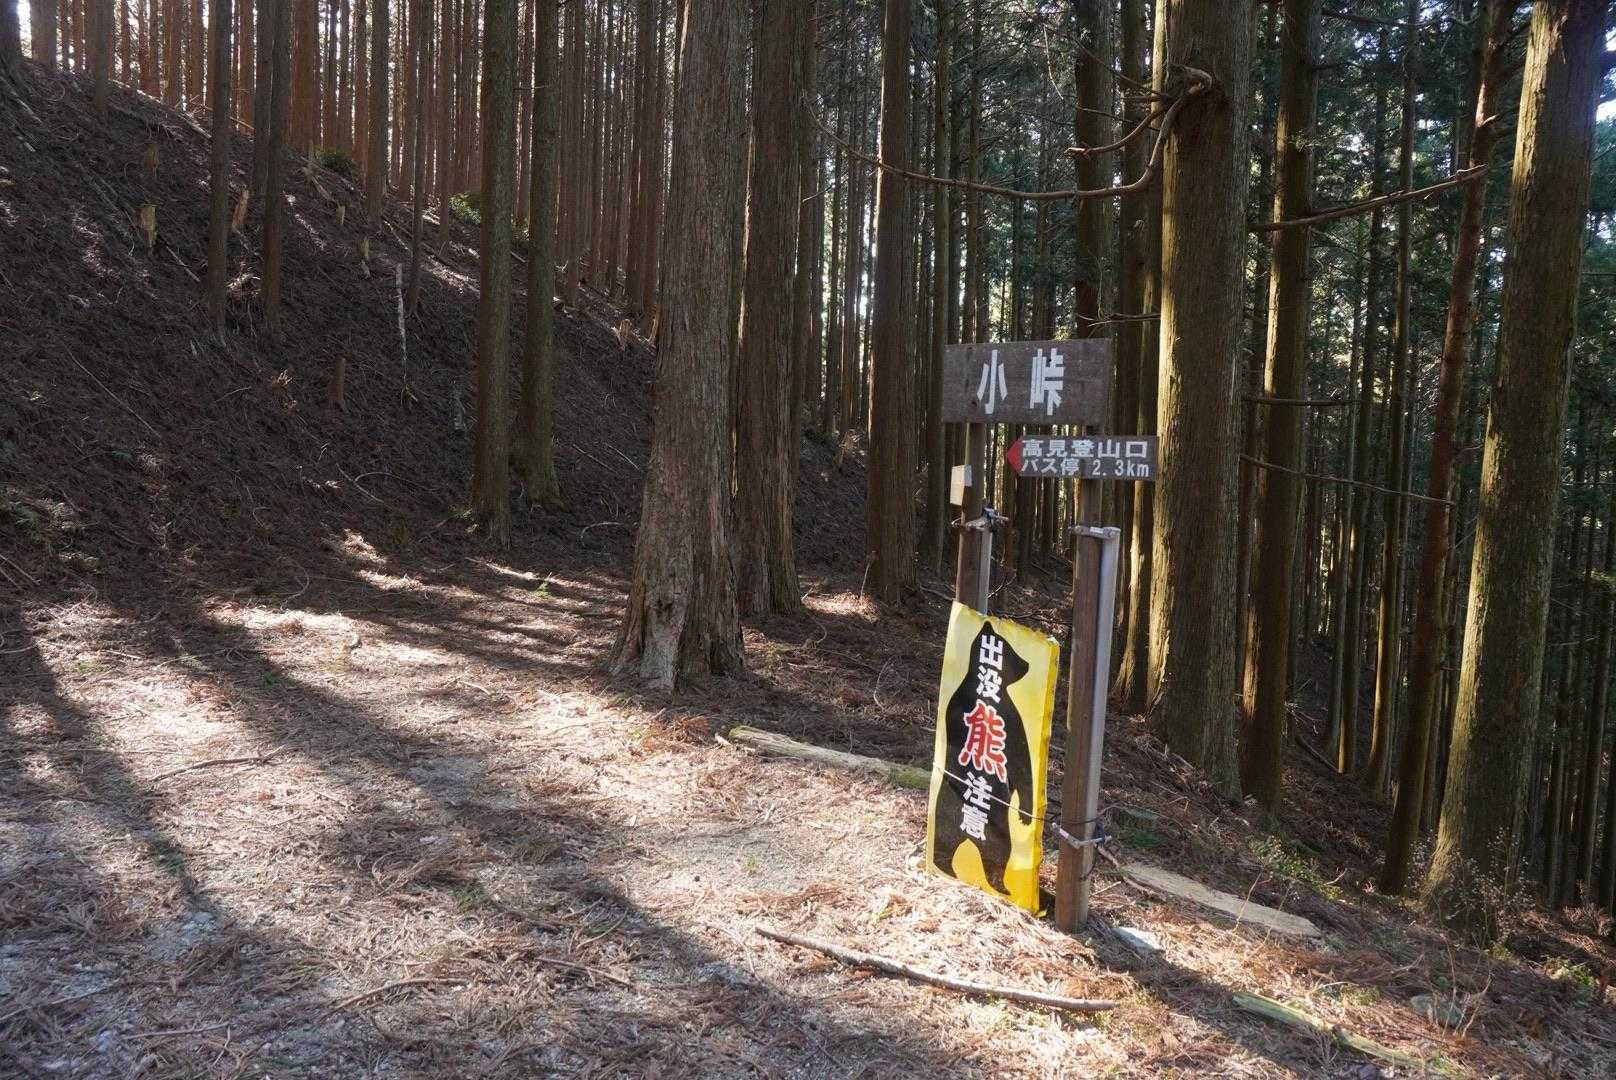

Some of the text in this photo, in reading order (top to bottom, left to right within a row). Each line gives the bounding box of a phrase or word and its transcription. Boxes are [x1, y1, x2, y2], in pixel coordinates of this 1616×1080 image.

[976, 347, 1065, 416] 小峠
[1020, 457, 1150, 478] バス停 2.3km
[1021, 438, 1149, 459] 高見登山口
[957, 633, 1008, 842] 出没熊注意
